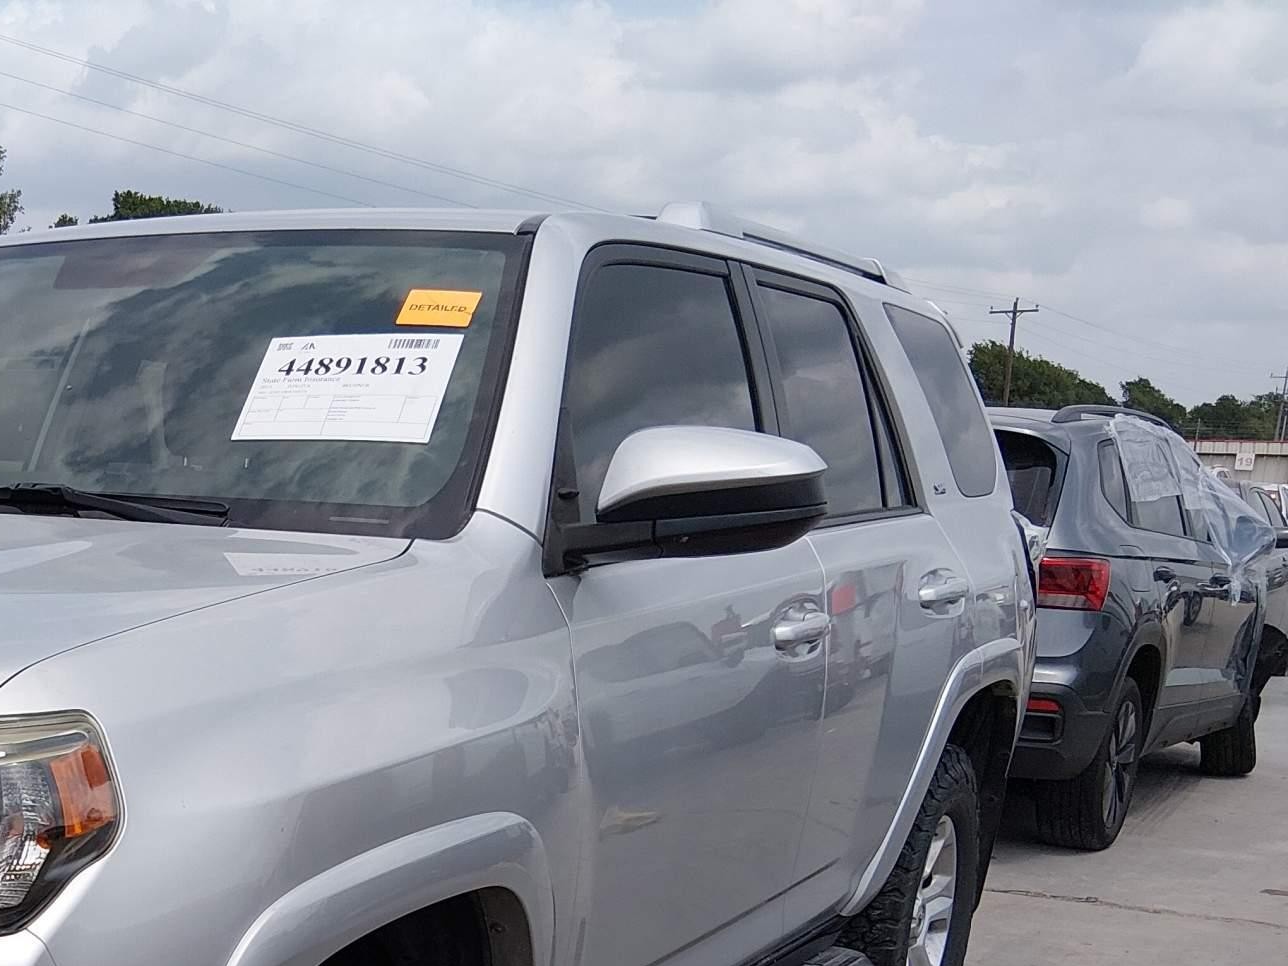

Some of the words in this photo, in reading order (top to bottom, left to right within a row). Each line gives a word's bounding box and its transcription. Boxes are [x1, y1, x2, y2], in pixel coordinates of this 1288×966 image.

[408, 303, 467, 313] DETAILED
[277, 355, 429, 376] 44891813
[1237, 457, 1253, 467] 19
